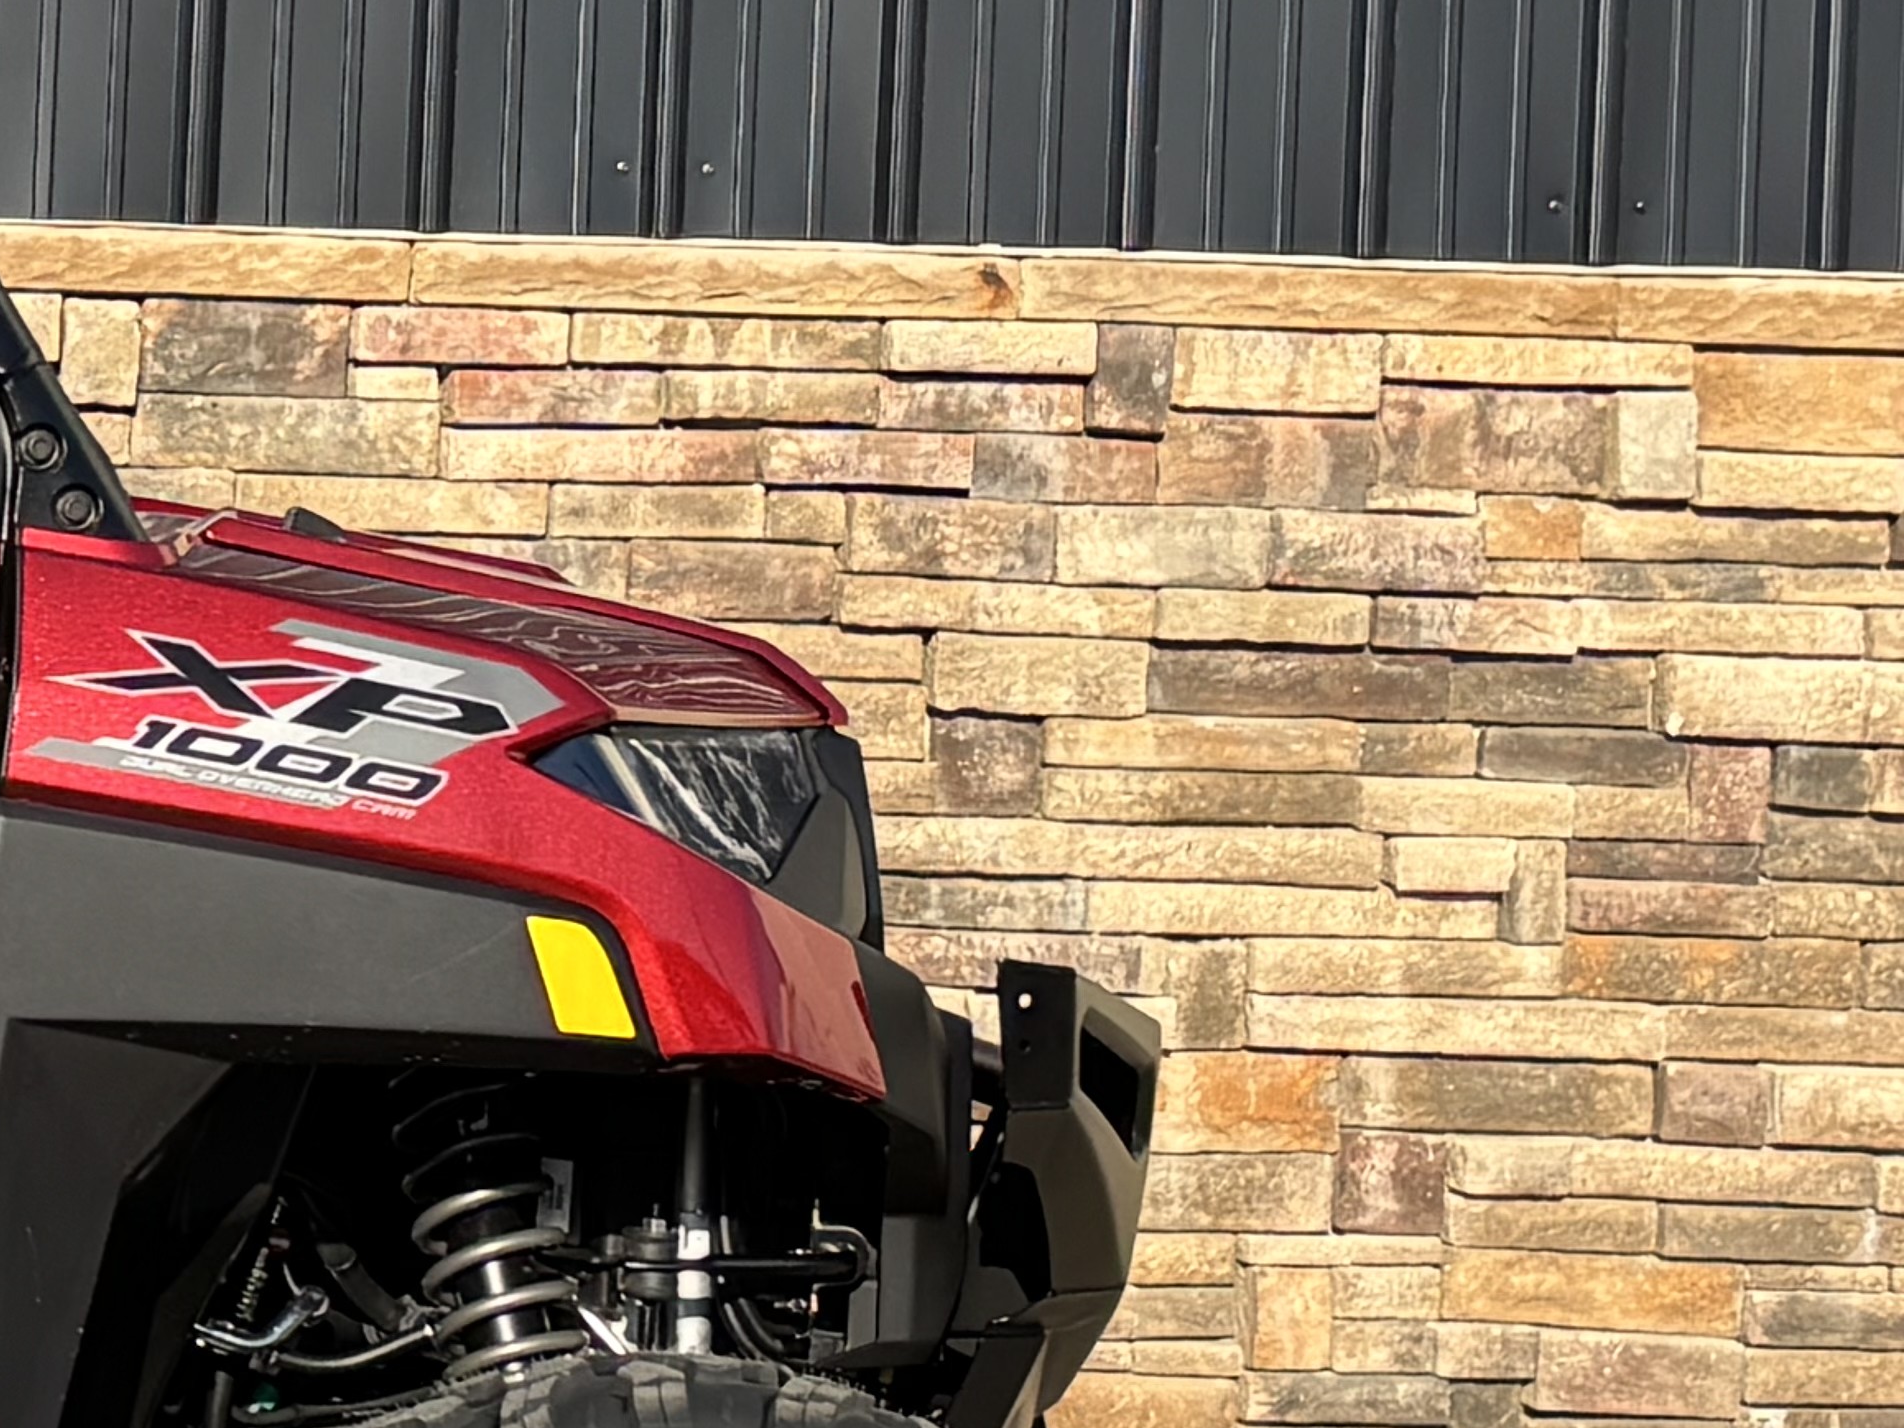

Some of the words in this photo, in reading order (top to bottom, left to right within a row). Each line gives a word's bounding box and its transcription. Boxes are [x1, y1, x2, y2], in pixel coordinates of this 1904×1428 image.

[51, 629, 518, 738] XP
[119, 756, 194, 778] DUAL
[196, 771, 351, 807] OVERHEAD
[352, 798, 417, 821] CAM
[131, 719, 447, 806] 1000
